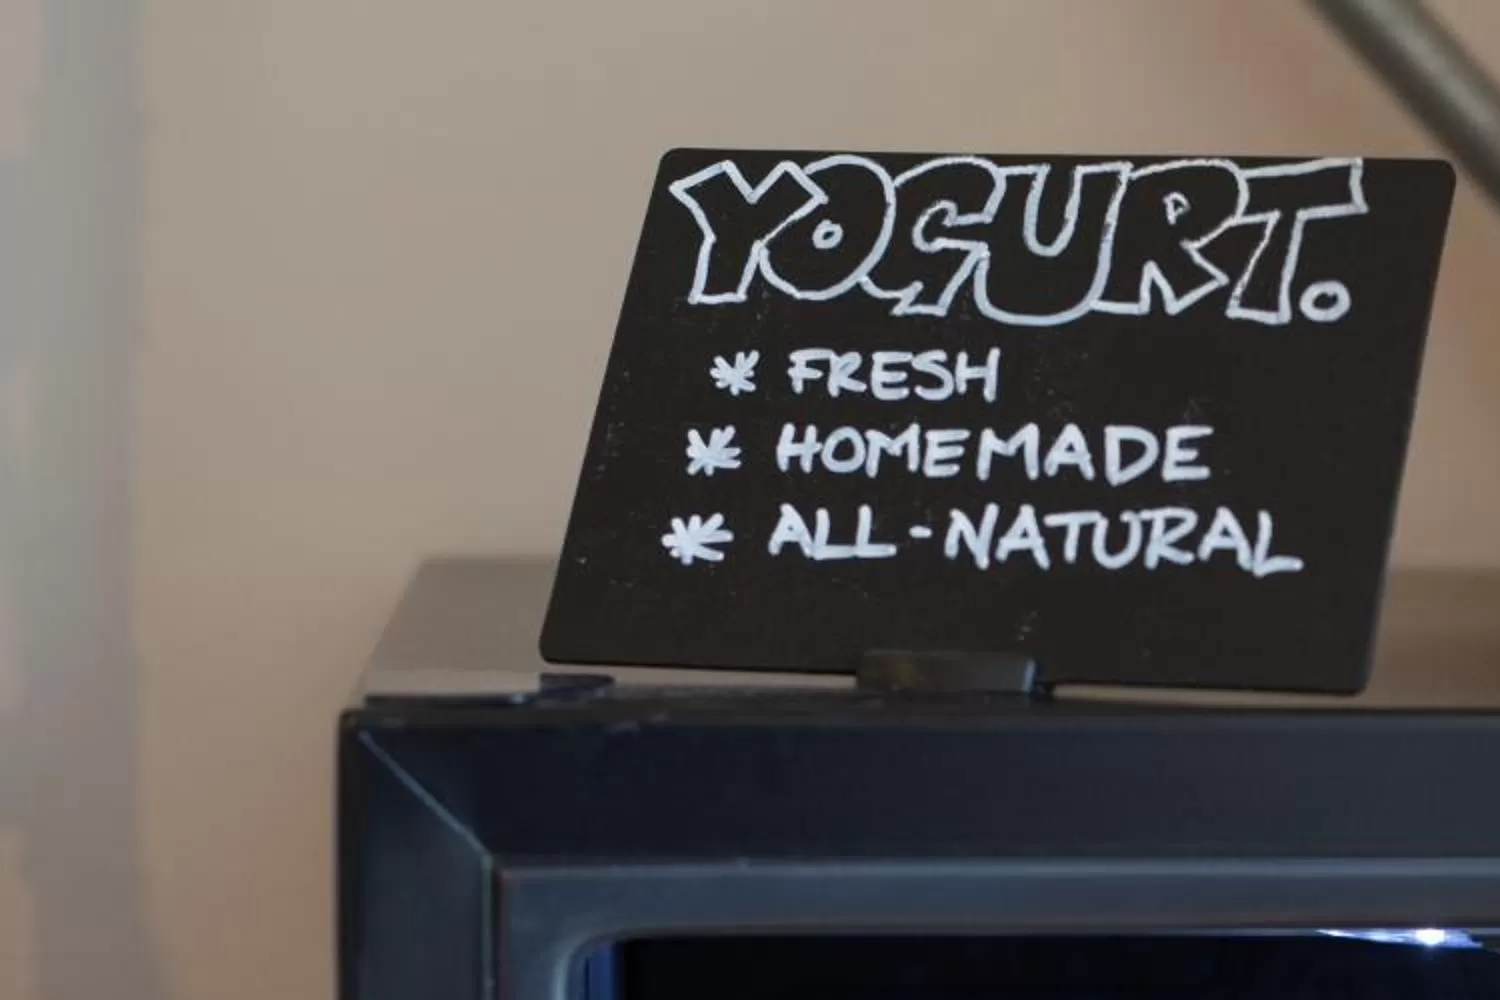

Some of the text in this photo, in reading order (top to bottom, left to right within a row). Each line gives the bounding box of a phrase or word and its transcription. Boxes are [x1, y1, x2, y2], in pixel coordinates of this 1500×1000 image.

[667, 154, 1368, 325] YOGURT.
[787, 347, 1001, 402] FRESH
[776, 422, 1213, 486] HOMEMADE
[767, 502, 1303, 577] ALL-NATURAL
